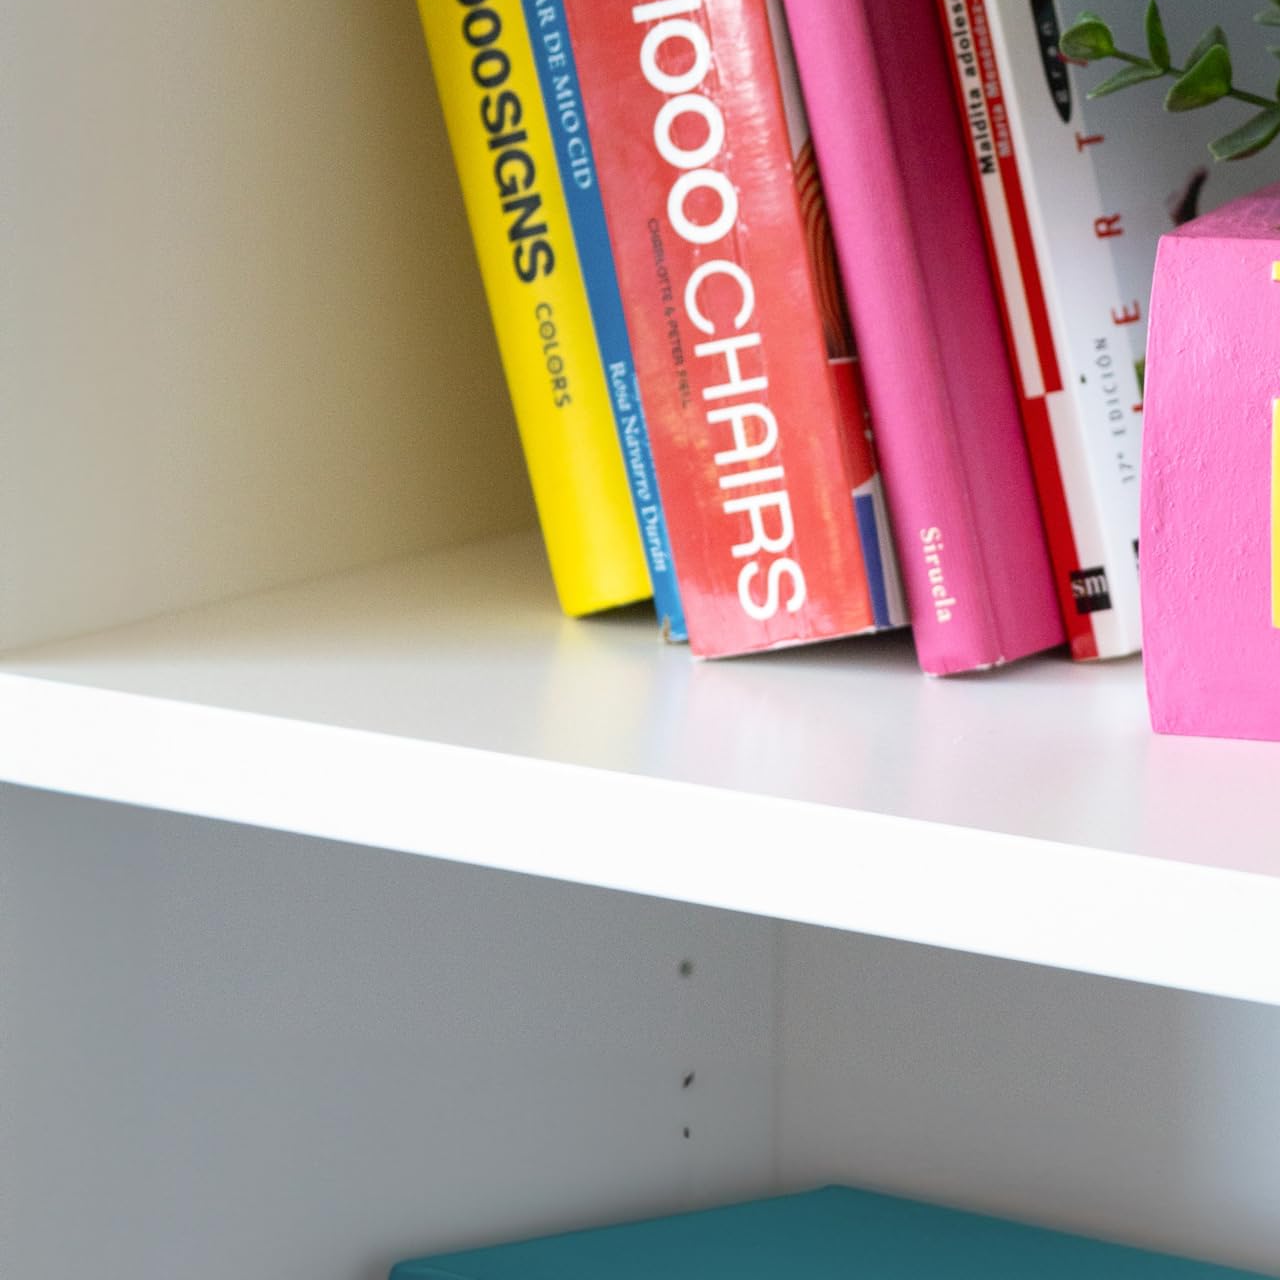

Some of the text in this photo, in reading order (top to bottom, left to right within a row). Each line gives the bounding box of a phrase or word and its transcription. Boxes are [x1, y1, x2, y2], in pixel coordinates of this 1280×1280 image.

[543, 31, 569, 73] DE
[552, 75, 581, 131] MIO
[968, 86, 997, 176] Maldita
[566, 131, 593, 191] CID
[534, 302, 572, 410] COLORS
[667, 320, 684, 366] PETER
[609, 361, 631, 411] Rosa
[621, 414, 652, 503] Navarro
[683, 258, 808, 622] CHAIRS
[919, 527, 957, 624] Siruela
[1072, 574, 1107, 597] sm
